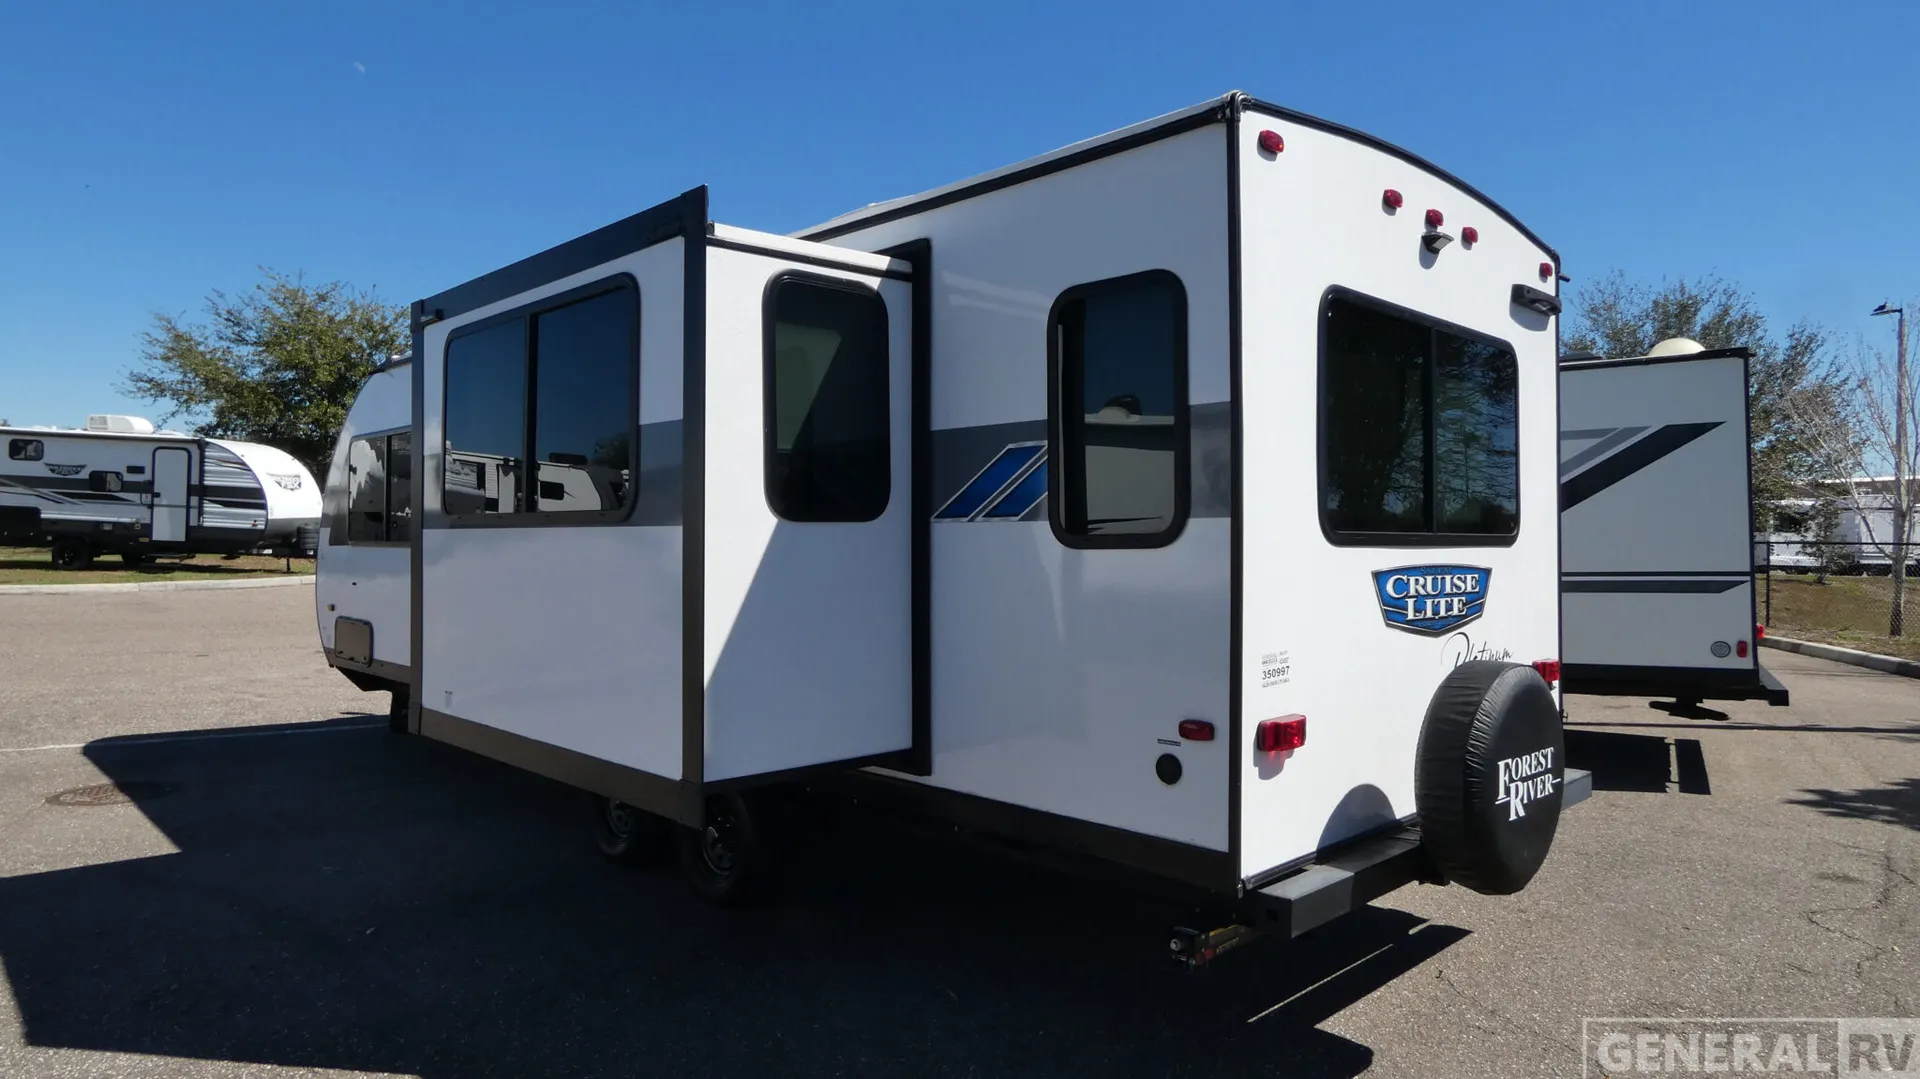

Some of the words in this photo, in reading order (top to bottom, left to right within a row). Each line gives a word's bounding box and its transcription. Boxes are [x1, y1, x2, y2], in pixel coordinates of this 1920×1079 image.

[1386, 574, 1480, 598] CRUISE
[1405, 596, 1467, 621] LITE
[1262, 665, 1290, 680] 350997
[1497, 747, 1554, 800] FOREST
[1508, 773, 1555, 821] RIVER
